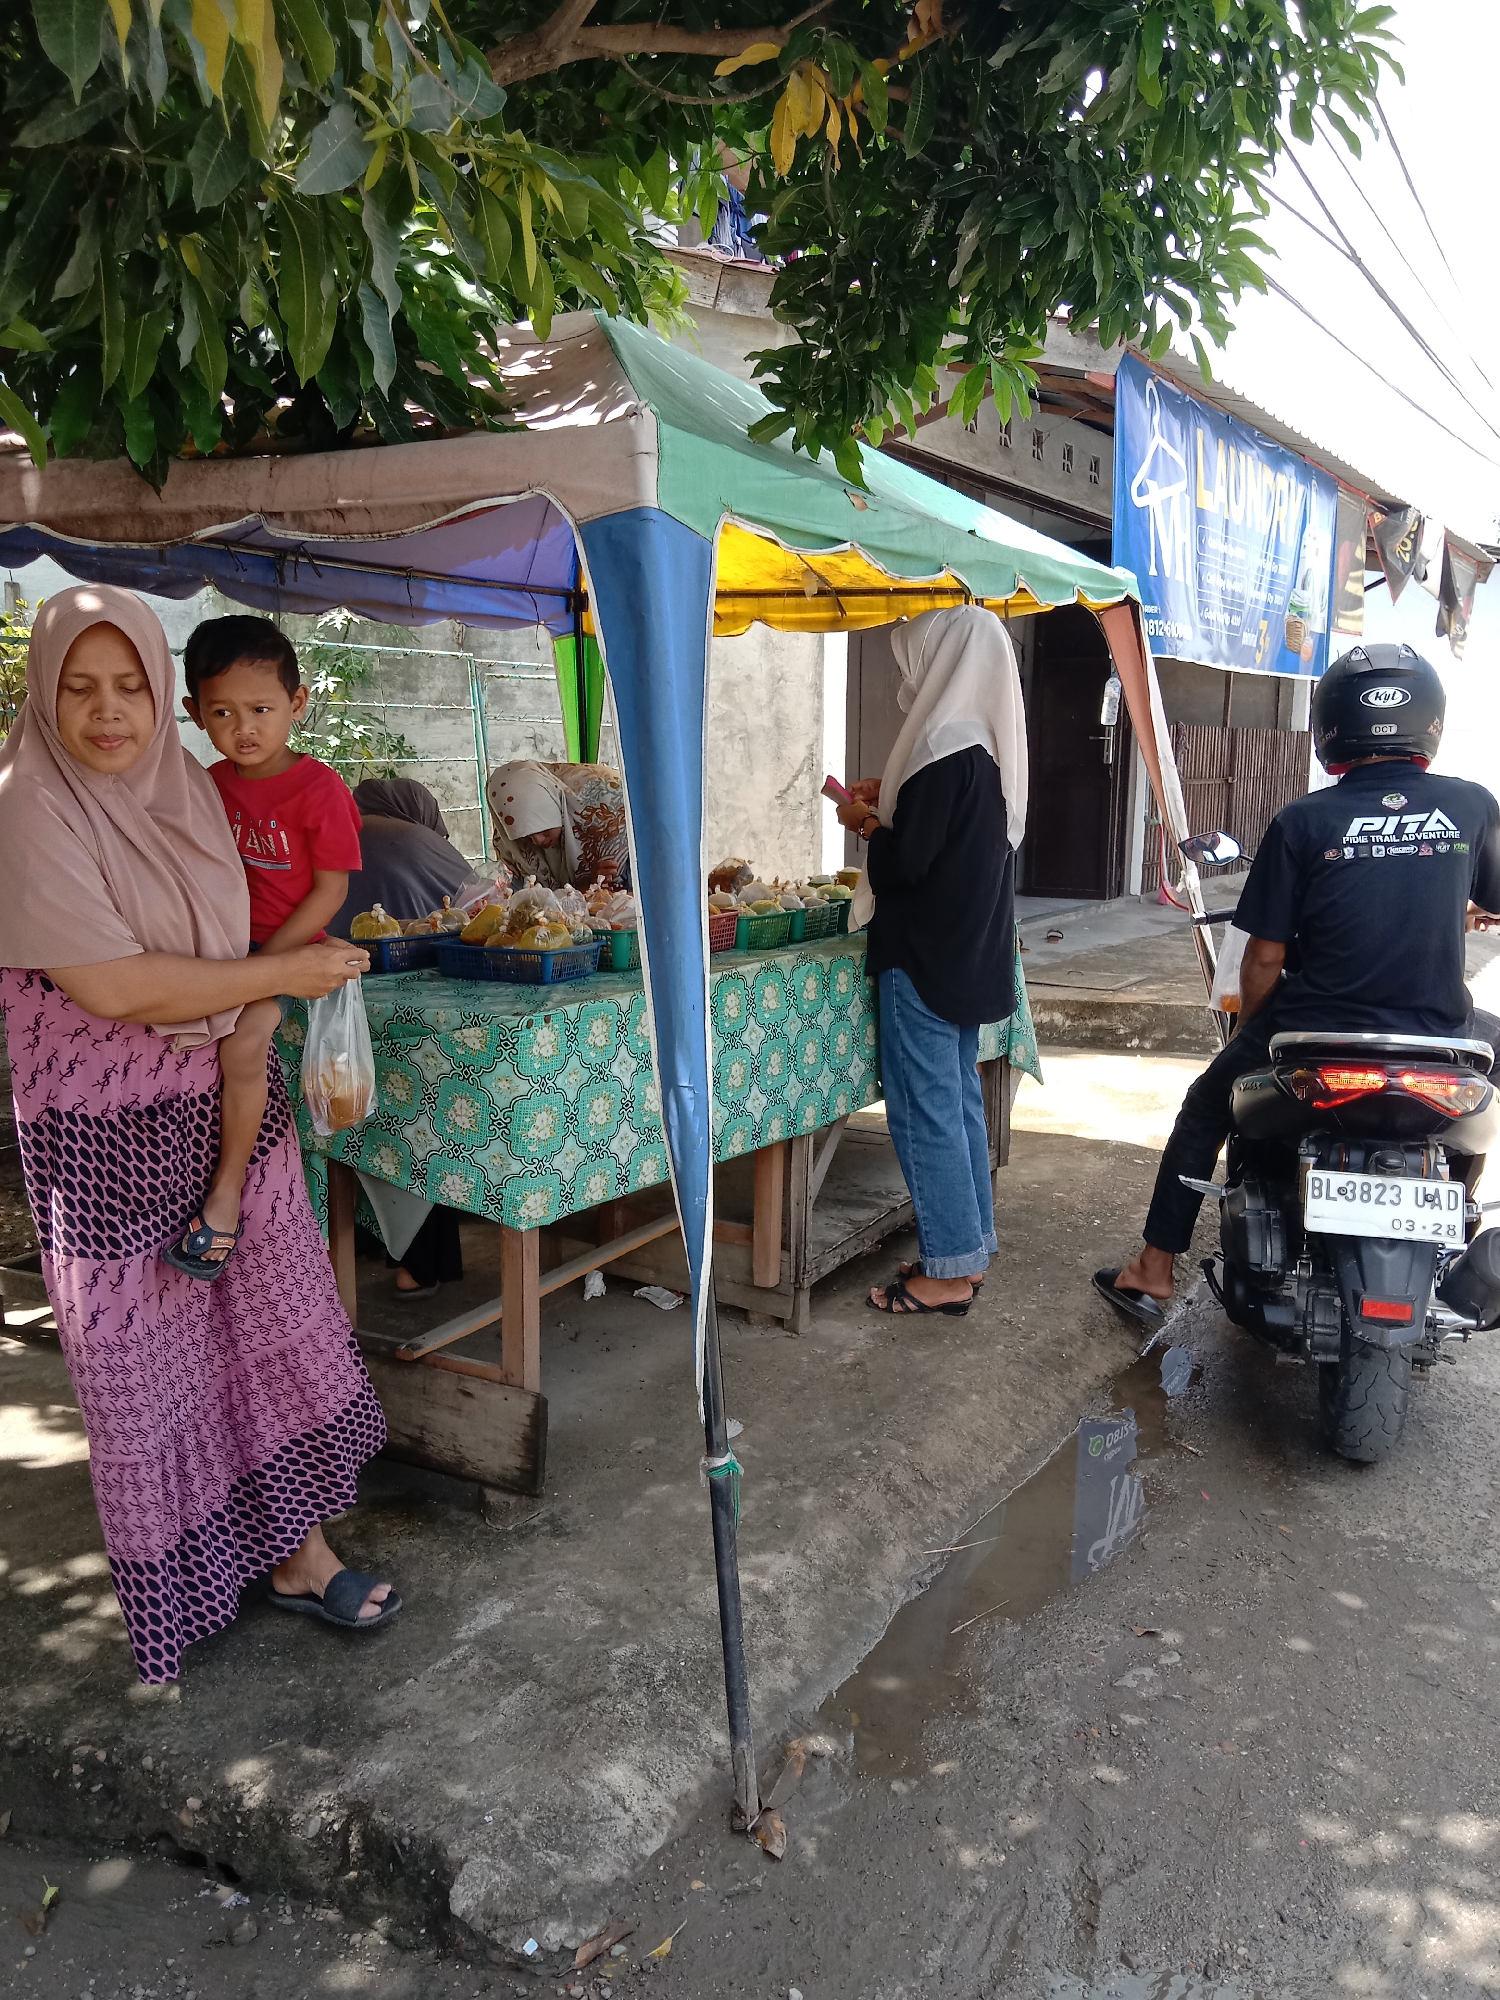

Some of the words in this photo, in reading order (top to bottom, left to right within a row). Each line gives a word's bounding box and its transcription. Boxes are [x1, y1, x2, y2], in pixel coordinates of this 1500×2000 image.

[1196, 427, 1306, 547] LAUNDRY
[1374, 725, 1394, 733] DCT
[1346, 808, 1457, 836] PITA
[1342, 835, 1369, 844] PIDIE
[1370, 834, 1400, 843] TRAIL
[1401, 830, 1461, 842] ADVENTURE
[1311, 1176, 1338, 1202] BL
[1344, 1180, 1402, 1207] 3823
[1414, 1186, 1459, 1212] UAD
